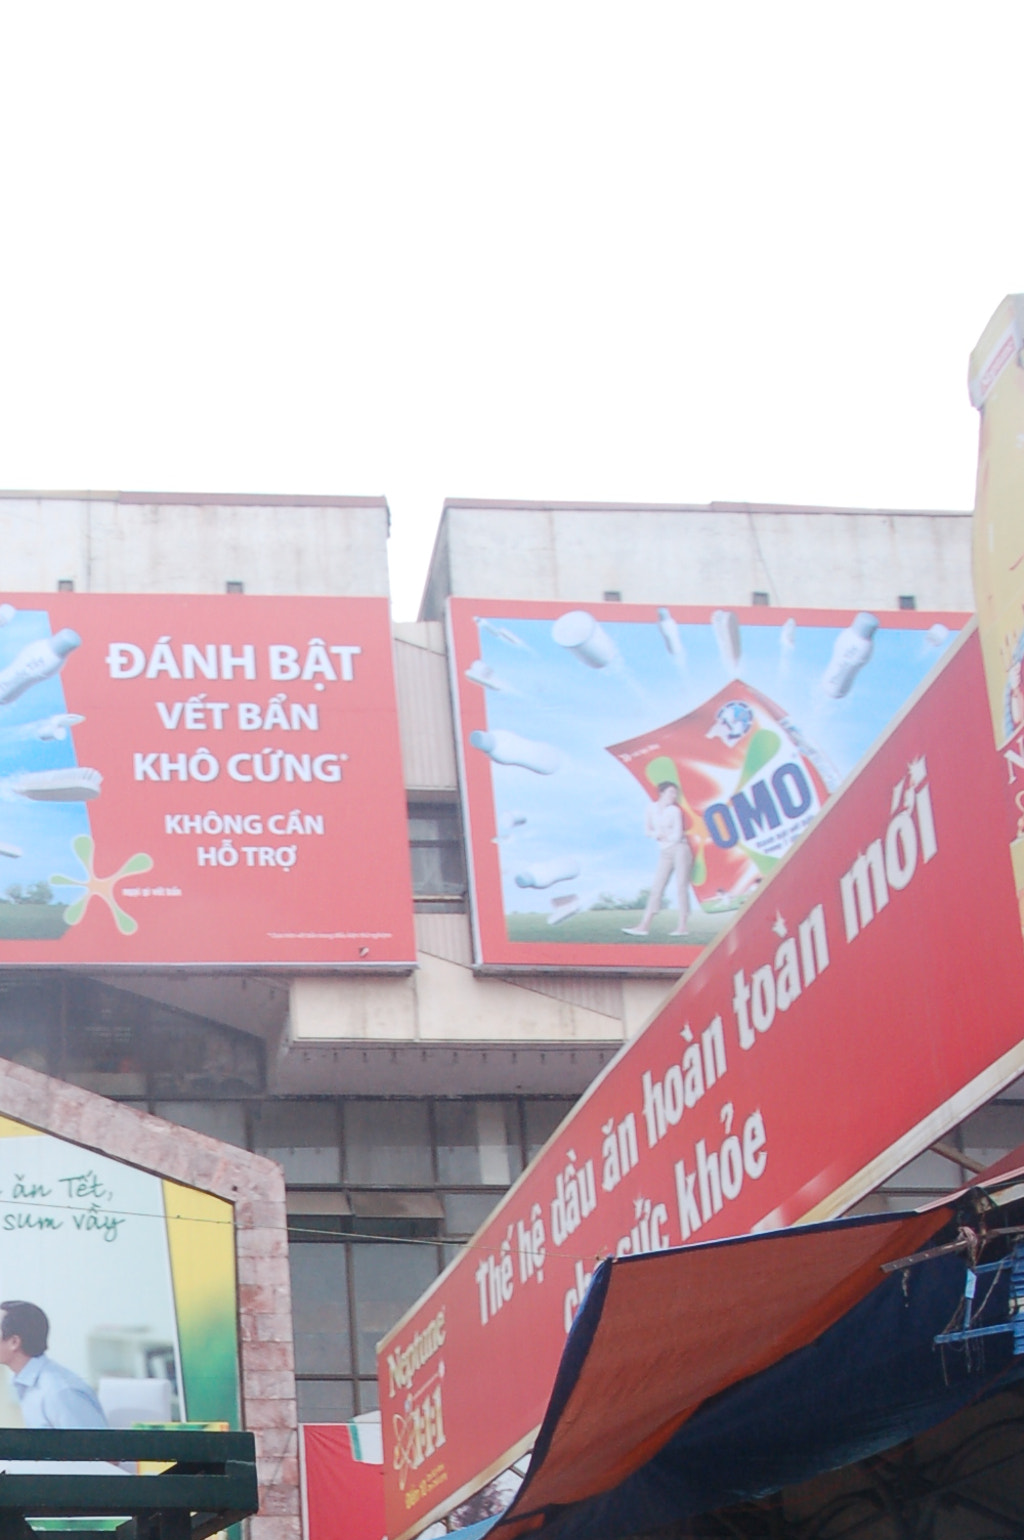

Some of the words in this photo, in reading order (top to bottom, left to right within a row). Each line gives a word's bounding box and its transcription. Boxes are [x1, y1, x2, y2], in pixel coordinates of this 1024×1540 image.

[105, 636, 256, 680] ĐÁNH
[269, 638, 361, 691] BẬT
[156, 693, 229, 731] VẾT
[238, 693, 319, 731] BẨN
[133, 747, 220, 782] KHÔ
[164, 810, 263, 835] KHÔNG
[268, 808, 324, 835] CẦN
[703, 762, 813, 849] OMO
[197, 839, 238, 867] HỖ
[242, 844, 298, 872] TRỢ
[476, 1222, 514, 1326] Thế
[518, 1202, 546, 1284] hệ
[550, 1148, 597, 1247] dầu
[601, 1110, 640, 1192] ăn
[642, 1013, 728, 1150] hoàn
[732, 903, 831, 1052] toàn
[839, 753, 939, 945] mới
[12, 1173, 52, 1199] ăn
[58, 1169, 114, 1202] Tết,
[3, 1214, 64, 1232] sum
[73, 1201, 127, 1242] vầy
[564, 1258, 606, 1334] ch
[674, 1101, 768, 1244] khỏe
[387, 1305, 447, 1399] Neptune
